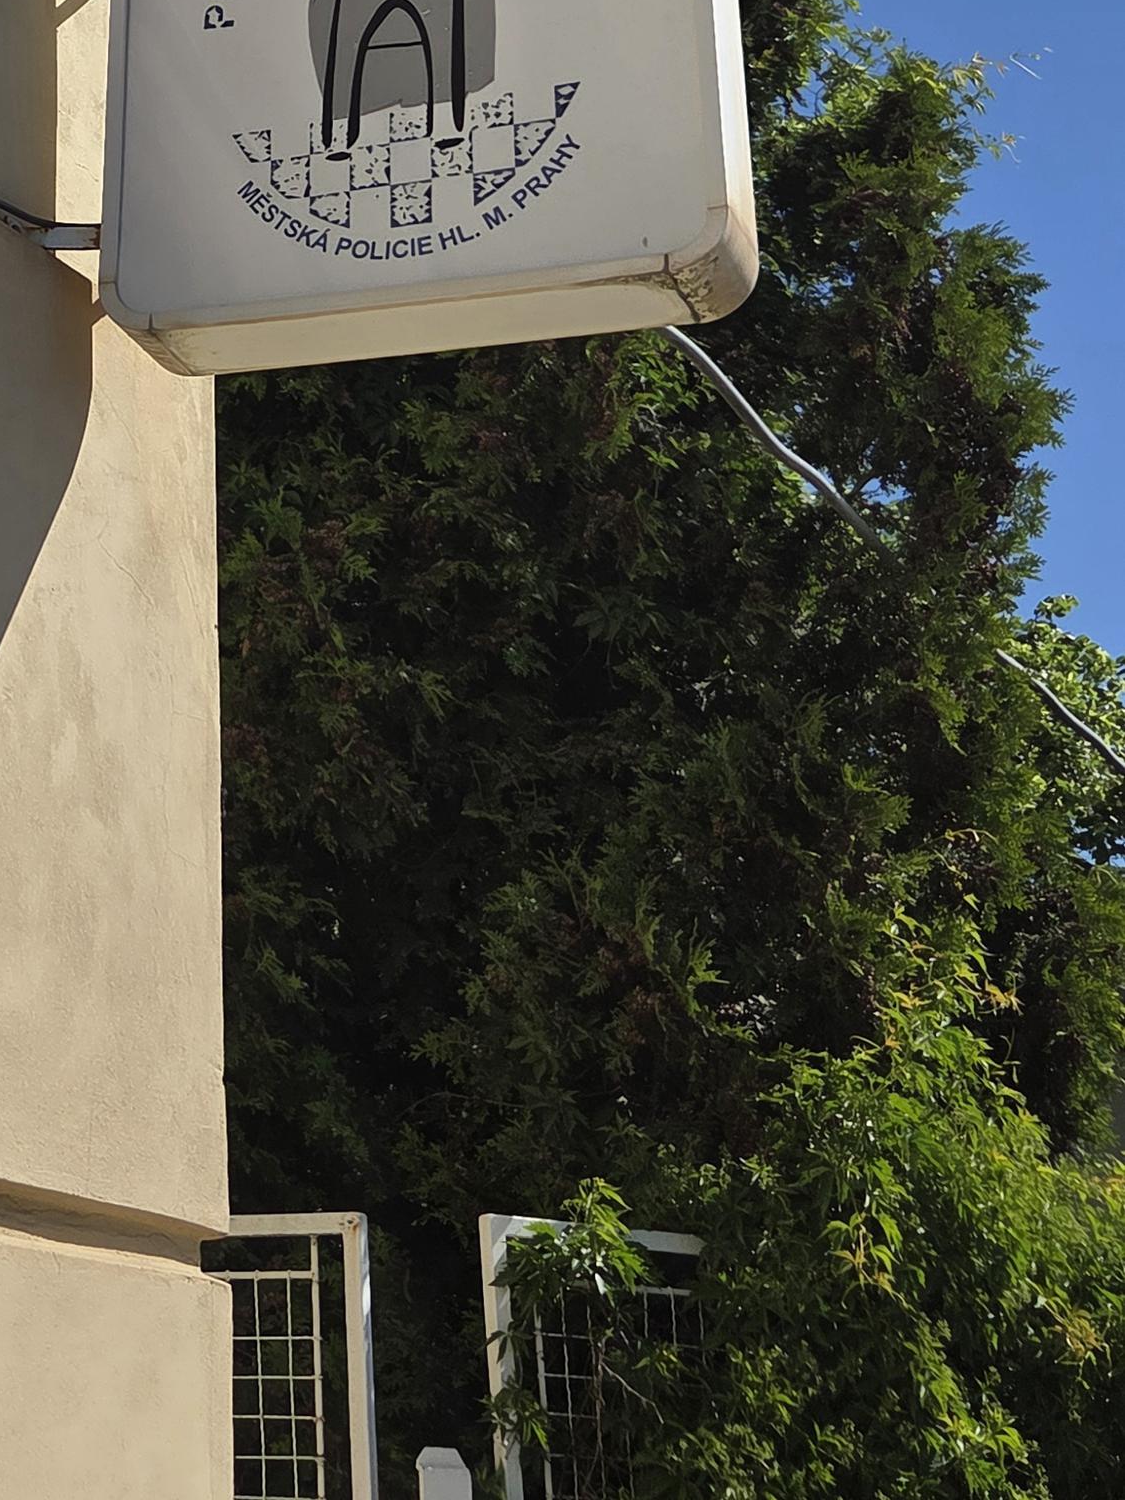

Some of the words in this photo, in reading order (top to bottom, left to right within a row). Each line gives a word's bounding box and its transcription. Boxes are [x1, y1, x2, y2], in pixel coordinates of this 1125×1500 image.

[237, 180, 330, 253] MĚSTSKÁ
[334, 235, 433, 260] POLICIE
[438, 224, 480, 250] HL.
[482, 205, 513, 229] M.
[510, 133, 581, 209] PRAHY
